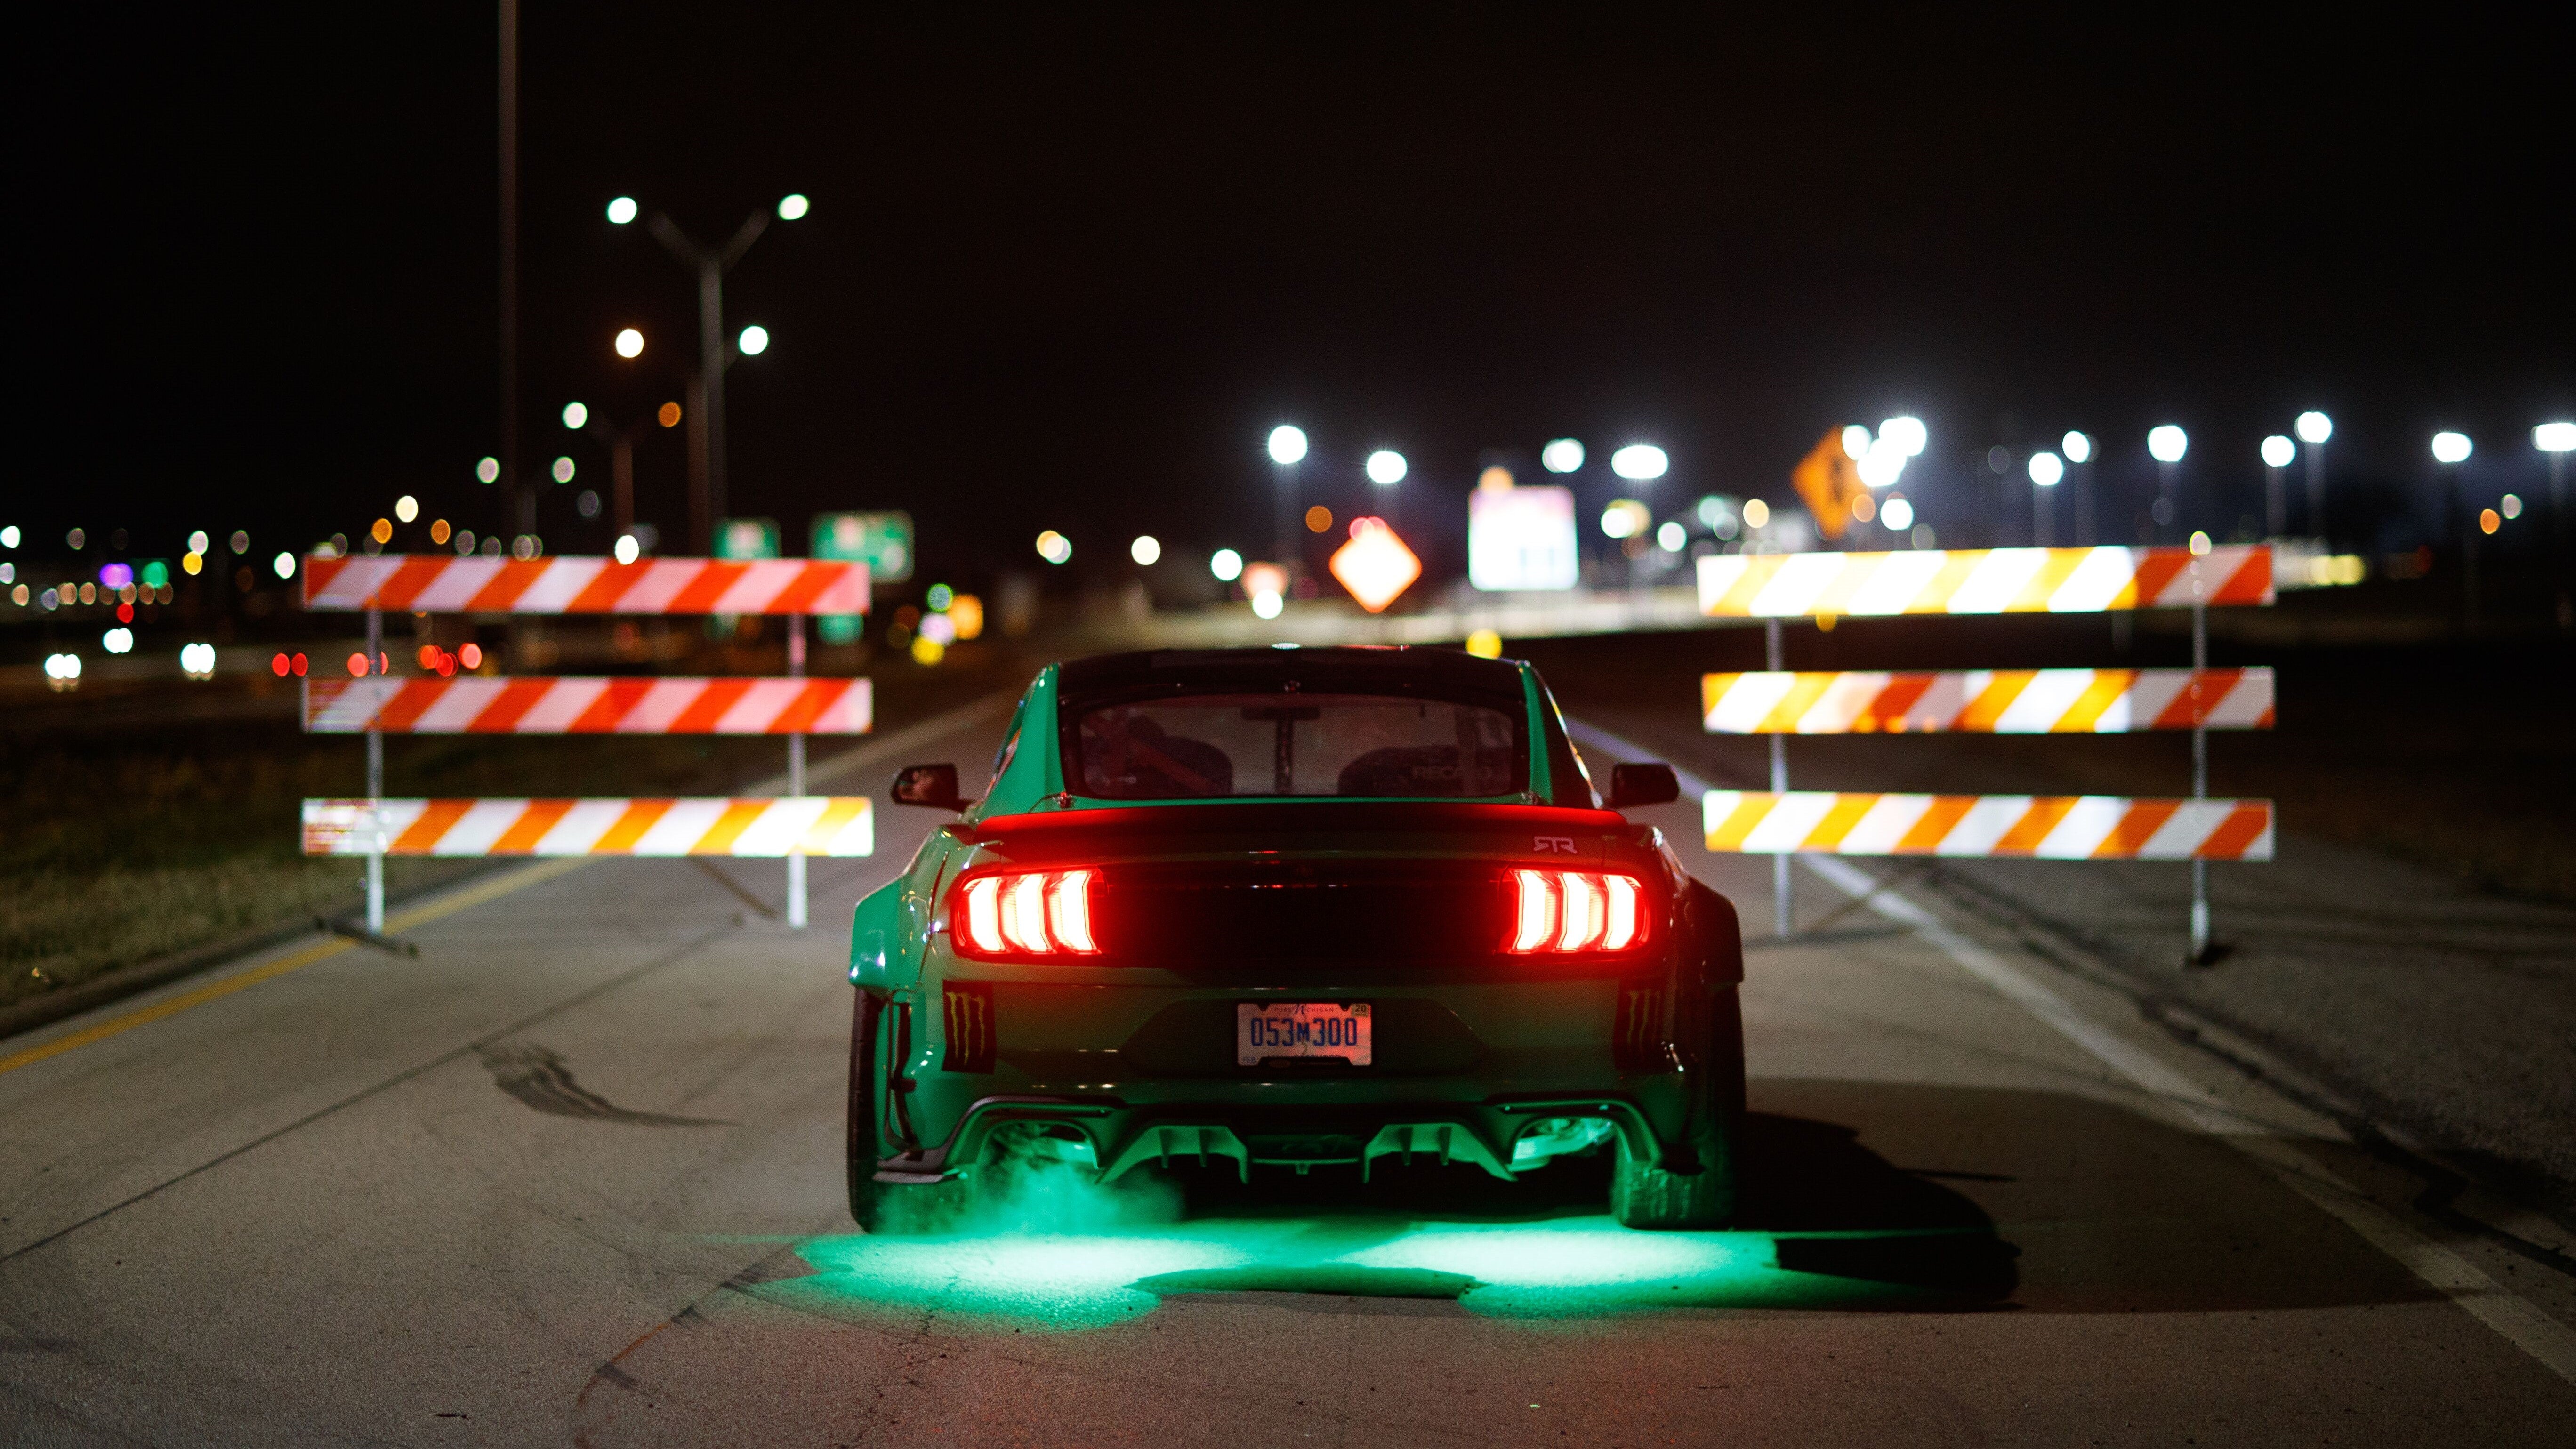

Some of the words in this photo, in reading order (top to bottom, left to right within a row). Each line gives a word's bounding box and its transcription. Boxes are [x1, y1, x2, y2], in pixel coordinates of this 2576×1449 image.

[1412, 765, 1493, 779] RECAO
[1355, 1004, 1366, 1012] 20
[1250, 1017, 1357, 1047] 053M300
